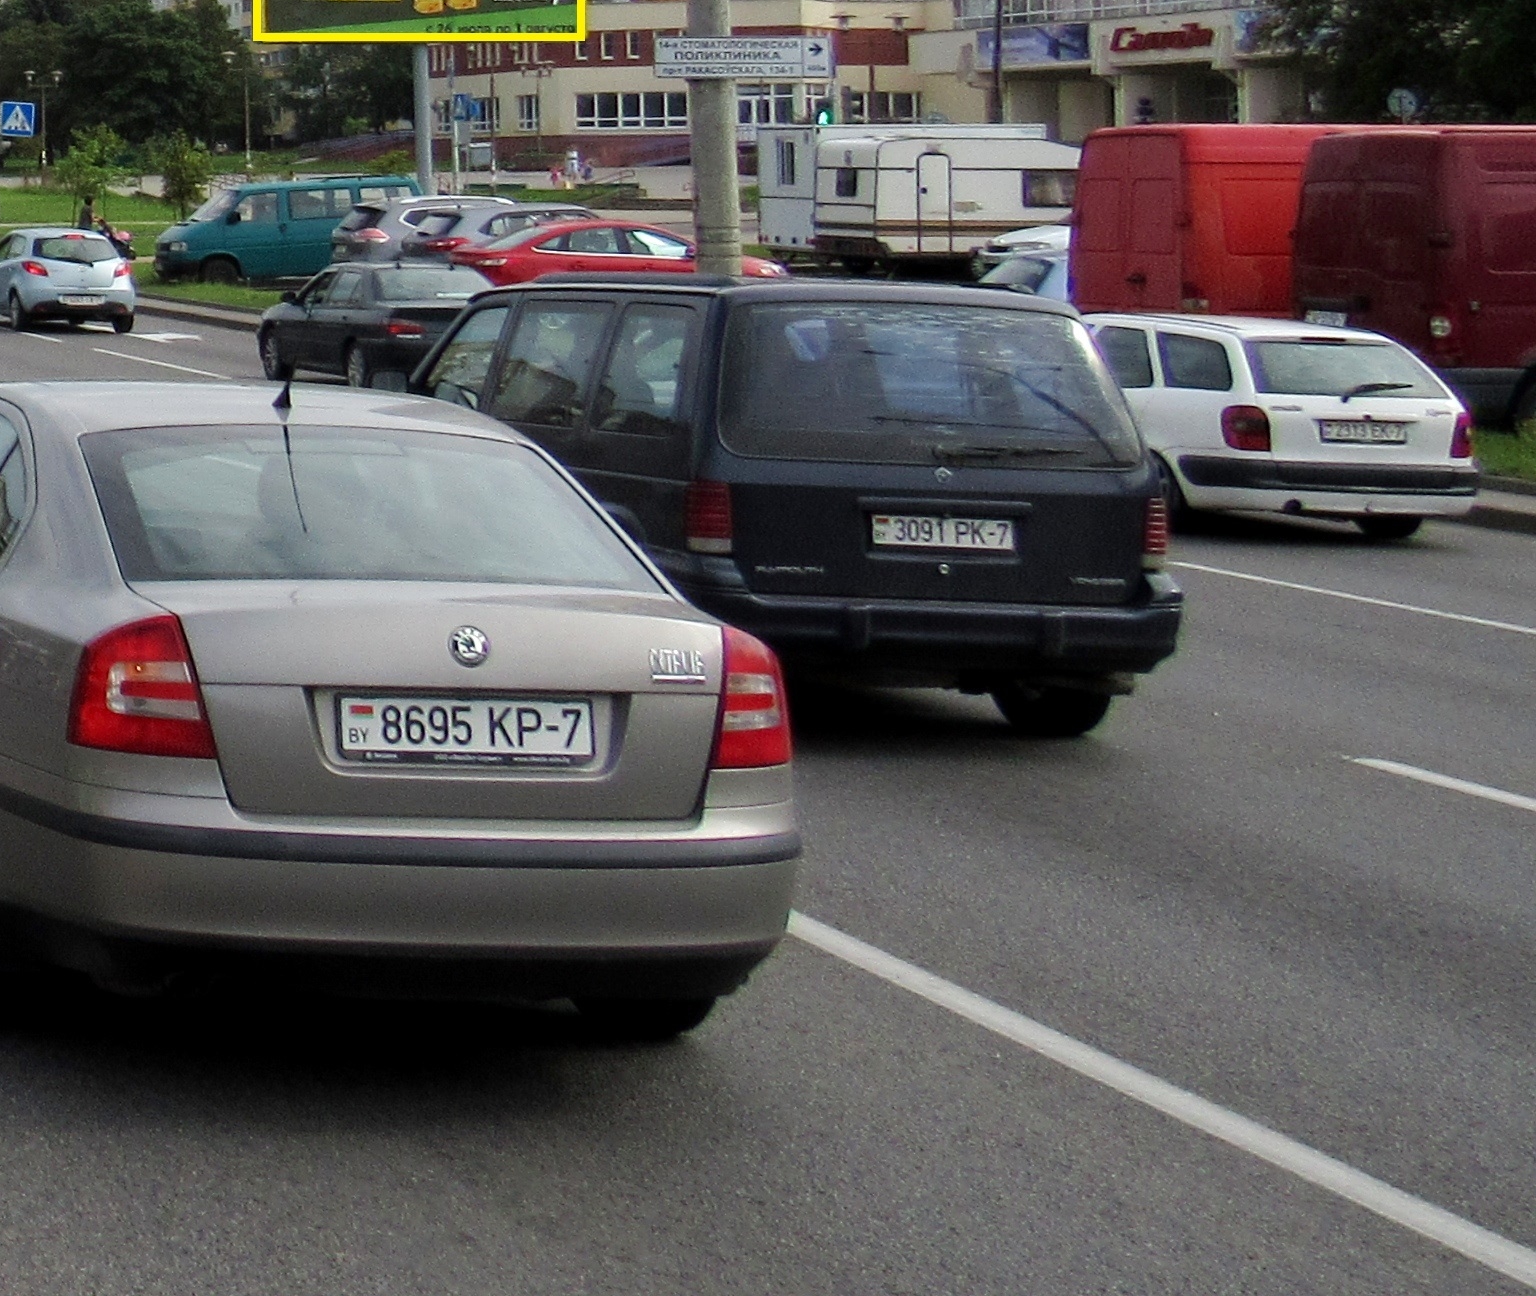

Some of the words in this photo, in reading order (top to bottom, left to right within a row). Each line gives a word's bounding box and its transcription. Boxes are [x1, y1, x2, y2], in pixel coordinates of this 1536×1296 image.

[680, 40, 798, 50] СТОМАТОЛОГИЧЕСКАЯ
[674, 51, 782, 61] ПОЛИКЛИНИКА
[893, 518, 944, 543] 3091
[955, 520, 1009, 546] PK-7
[380, 705, 473, 745] 8695
[488, 707, 583, 749] KP-7
[348, 728, 369, 743] BY
